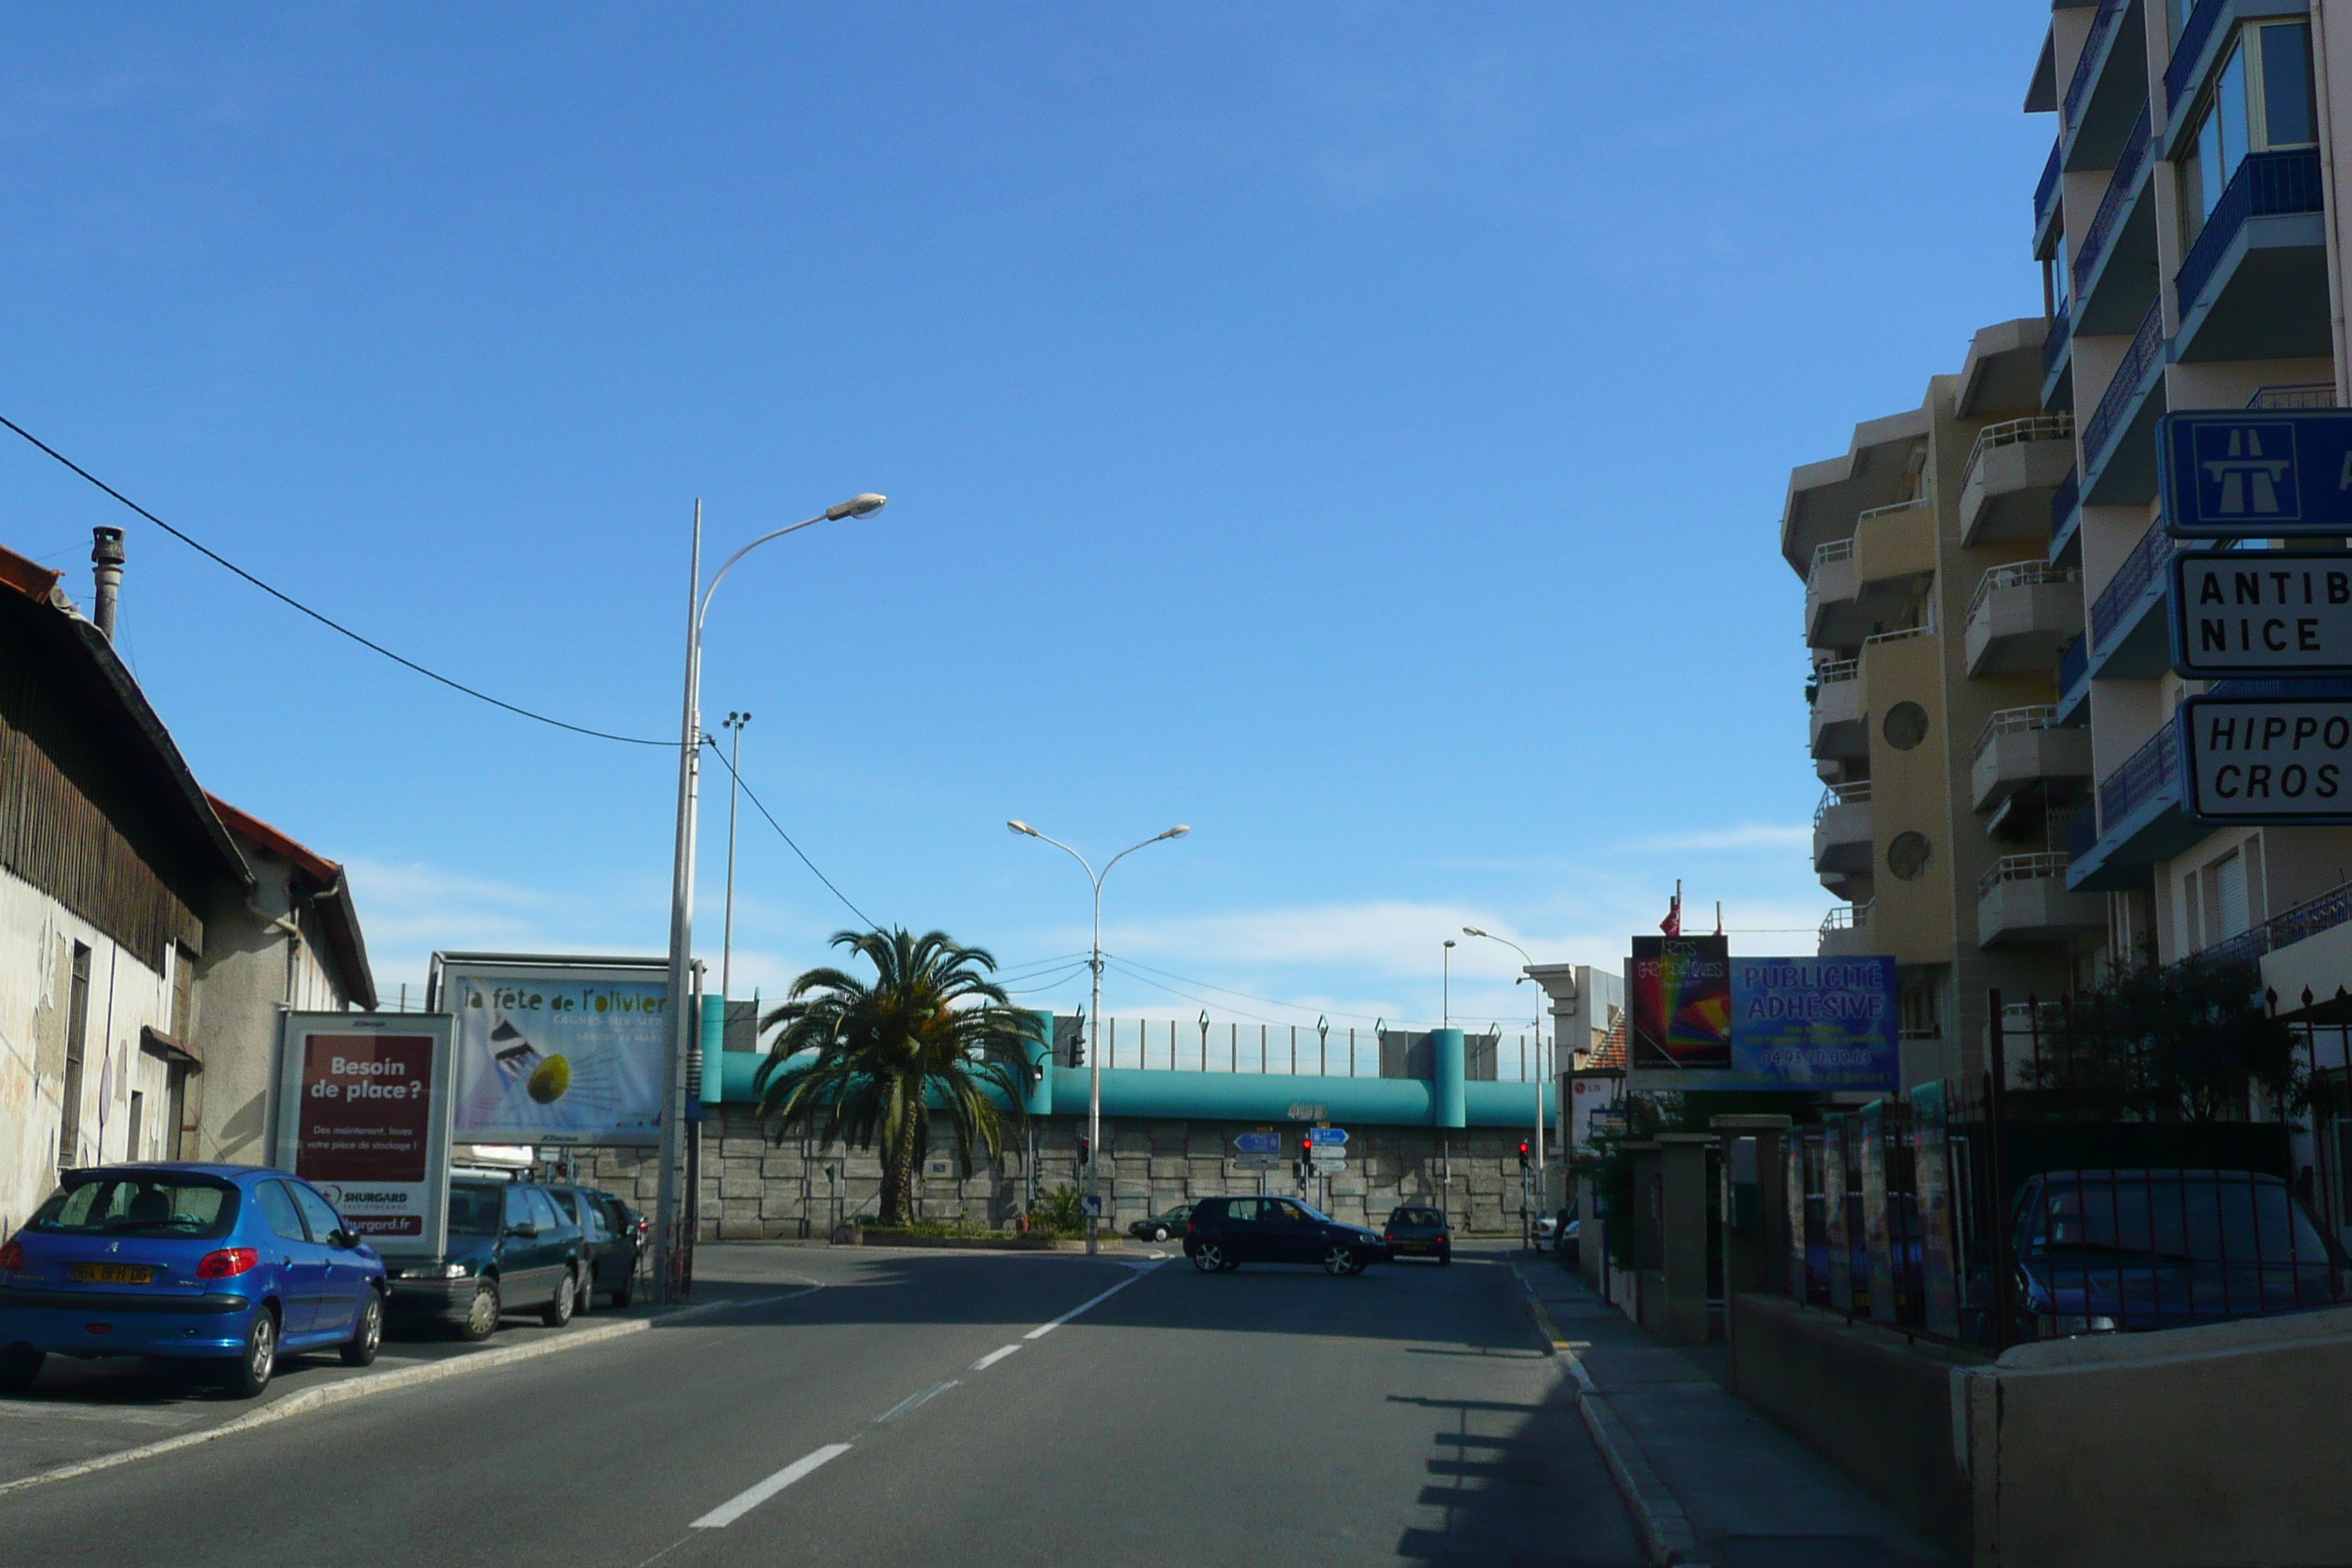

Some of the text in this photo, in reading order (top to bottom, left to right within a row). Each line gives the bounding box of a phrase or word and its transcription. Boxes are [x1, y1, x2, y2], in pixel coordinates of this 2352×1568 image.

[2199, 572, 2350, 605] ANTIB
[2201, 618, 2321, 652] NICE
[2209, 717, 2350, 750] HIPPO
[2215, 764, 2340, 798] CROS
[1744, 961, 1885, 990] PUBLICITÉ
[465, 986, 482, 1009] la
[493, 987, 542, 1011] fête
[551, 995, 573, 1011] de
[1747, 992, 1885, 1021] ADHÉSIVE
[331, 1057, 405, 1076] Besoin
[311, 1079, 339, 1098] de
[308, 1141, 330, 1150] votre
[358, 1140, 370, 1150] de
[344, 1192, 407, 1203] SHURGARD
[347, 1218, 412, 1233] hurgard.fr
